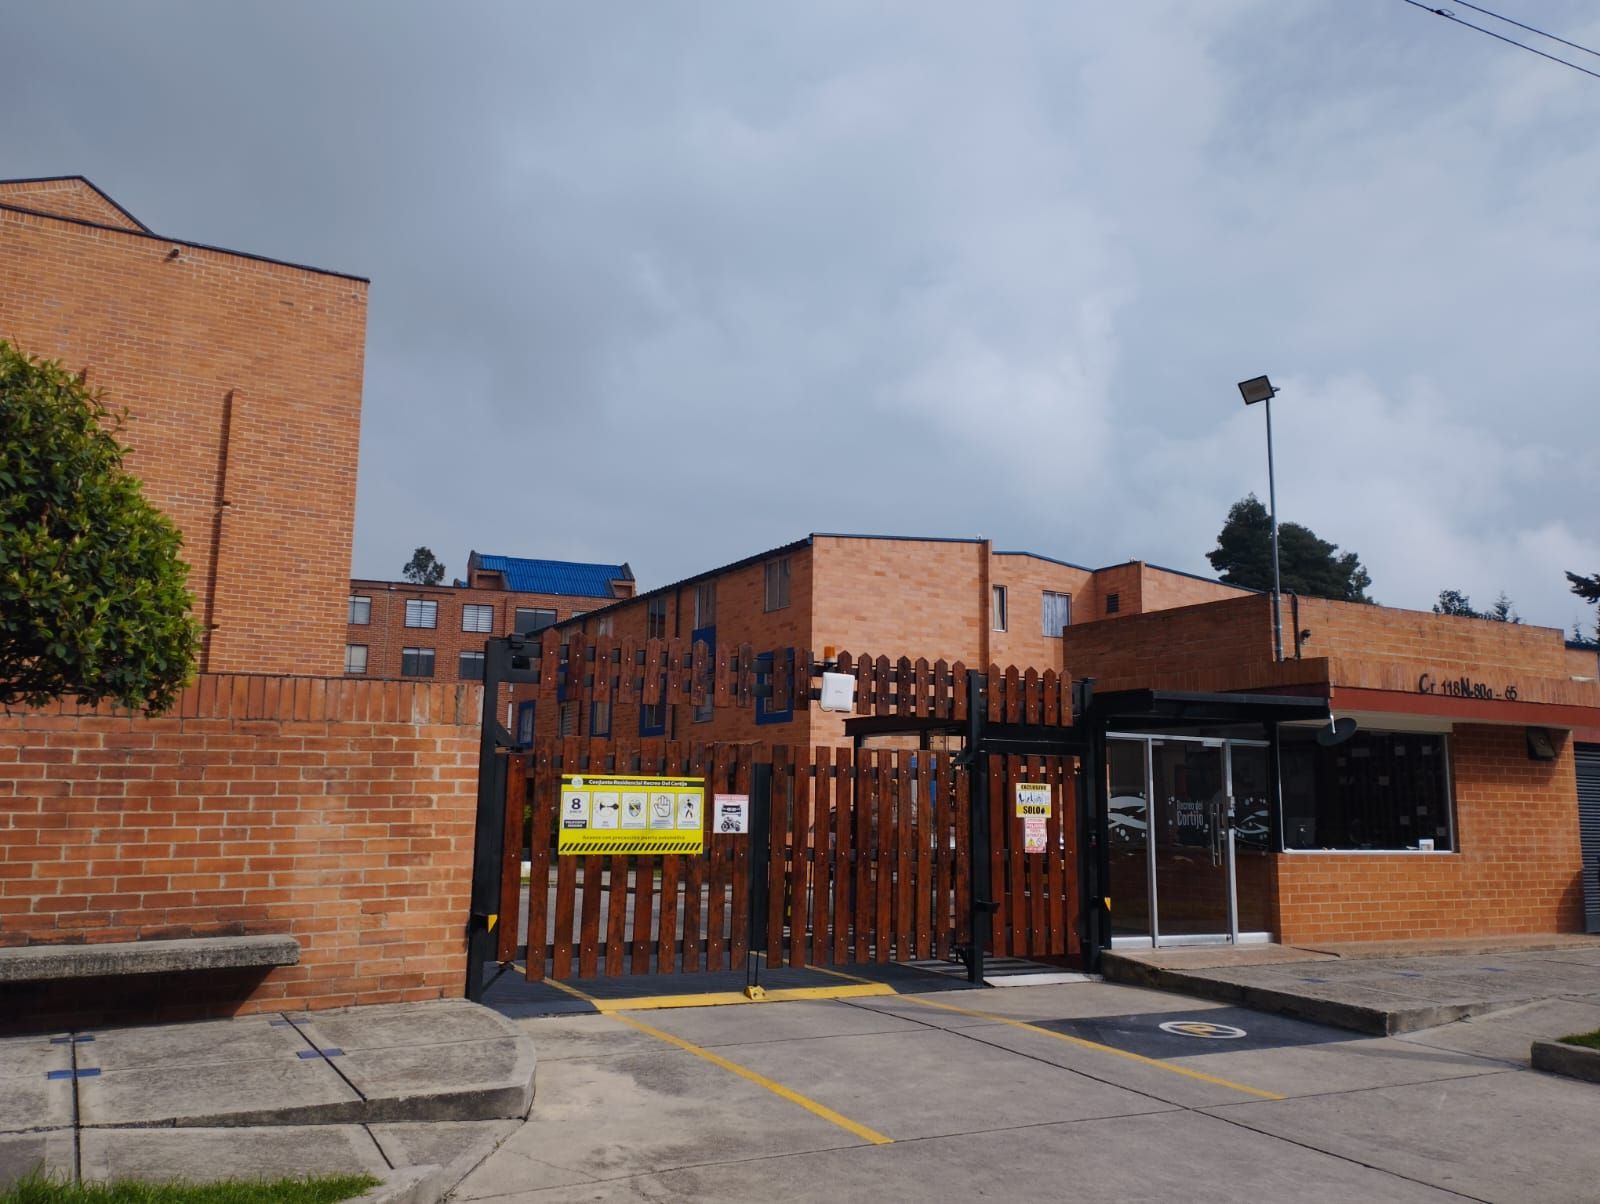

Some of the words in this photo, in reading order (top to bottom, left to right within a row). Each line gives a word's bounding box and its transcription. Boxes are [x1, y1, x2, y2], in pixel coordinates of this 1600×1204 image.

[1419, 673, 1435, 693] Cr
[1441, 680, 1460, 696] 118
[1505, 686, 1517, 700] 65
[571, 798, 581, 810] 8
[1023, 806, 1040, 814] SOLO
[1177, 810, 1203, 829] Cortijo
